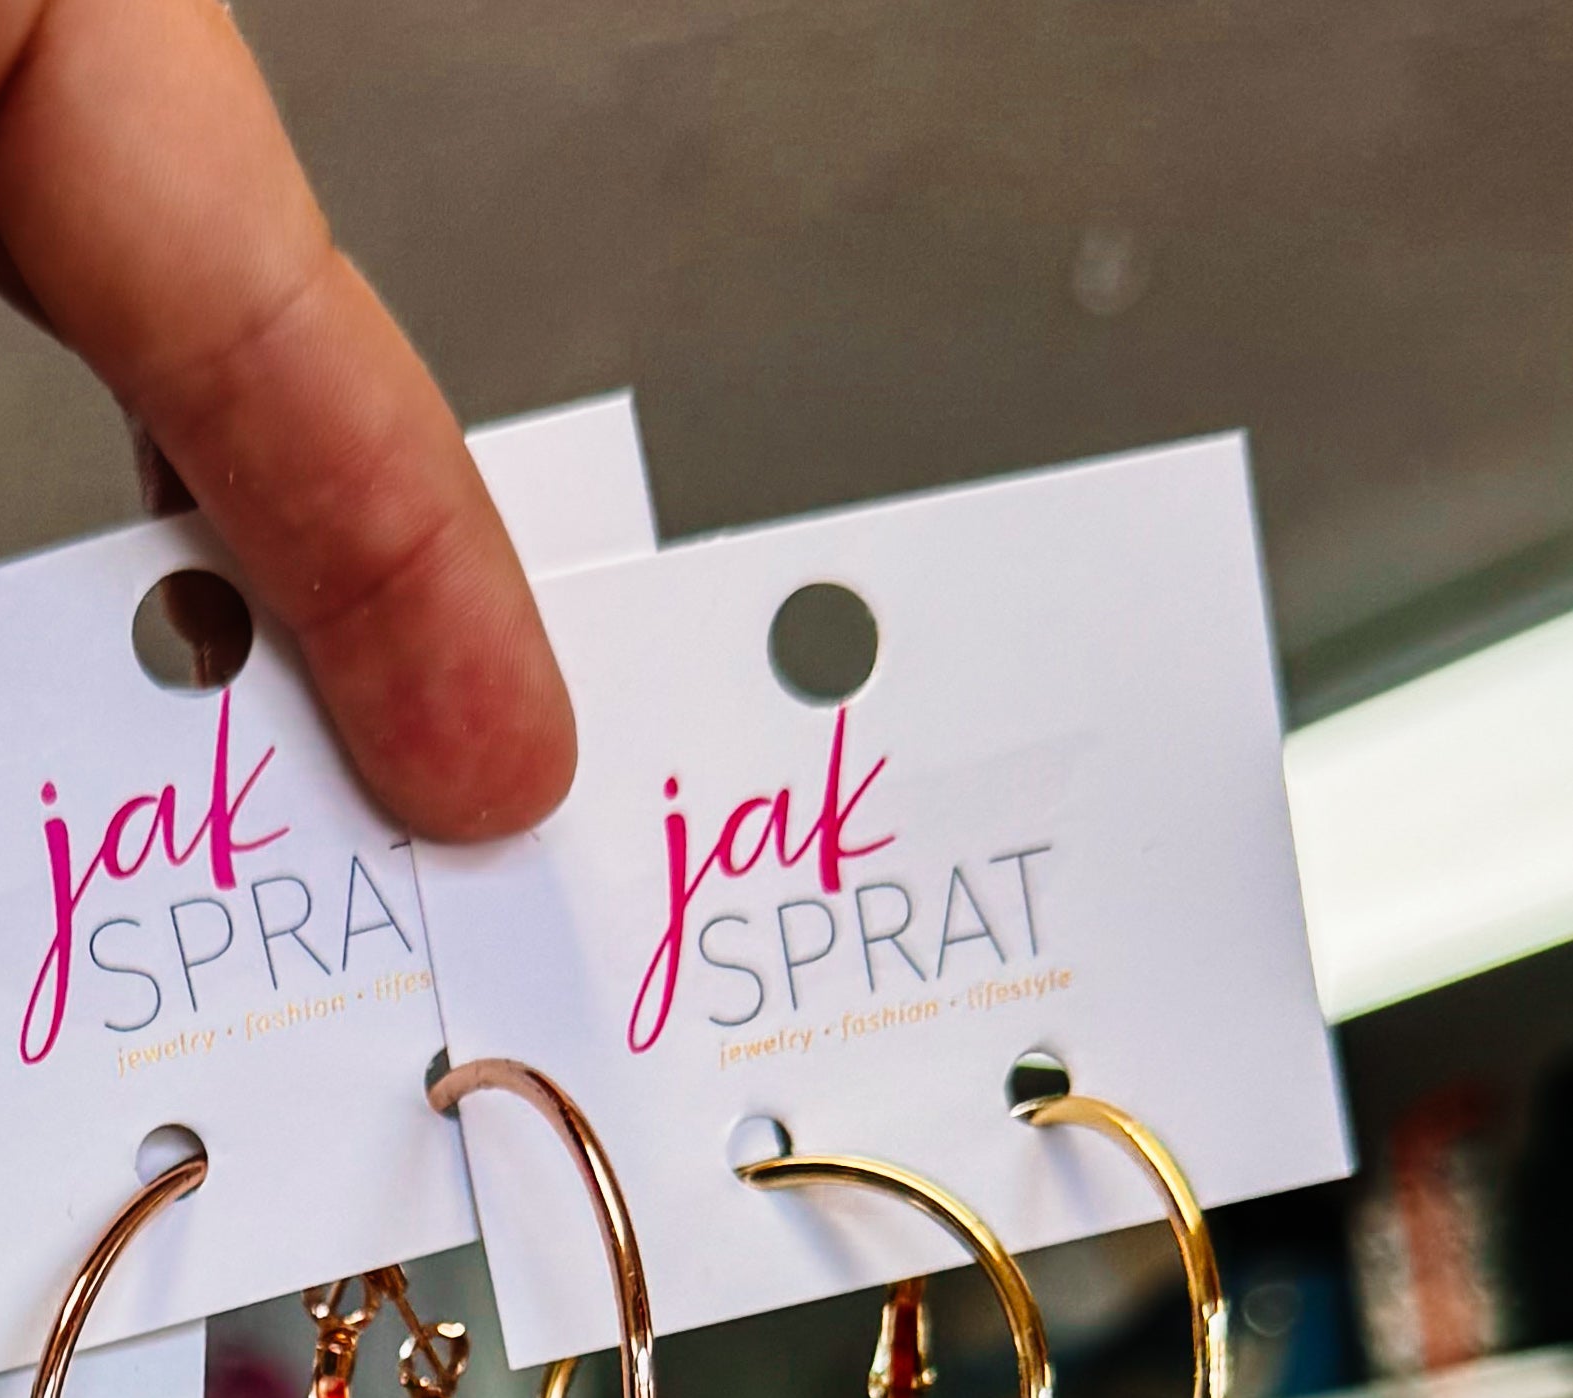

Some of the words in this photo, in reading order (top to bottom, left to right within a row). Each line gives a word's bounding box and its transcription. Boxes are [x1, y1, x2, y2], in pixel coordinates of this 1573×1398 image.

[19, 687, 291, 1065] jak
[627, 703, 897, 1055] jak
[698, 845, 1053, 1028] SPRAT
[118, 1028, 217, 1078] jewelry
[244, 993, 345, 1041] fashion
[719, 1027, 815, 1070] jewelry
[841, 998, 939, 1041] fashion
[966, 968, 1073, 1011] lifestyle
